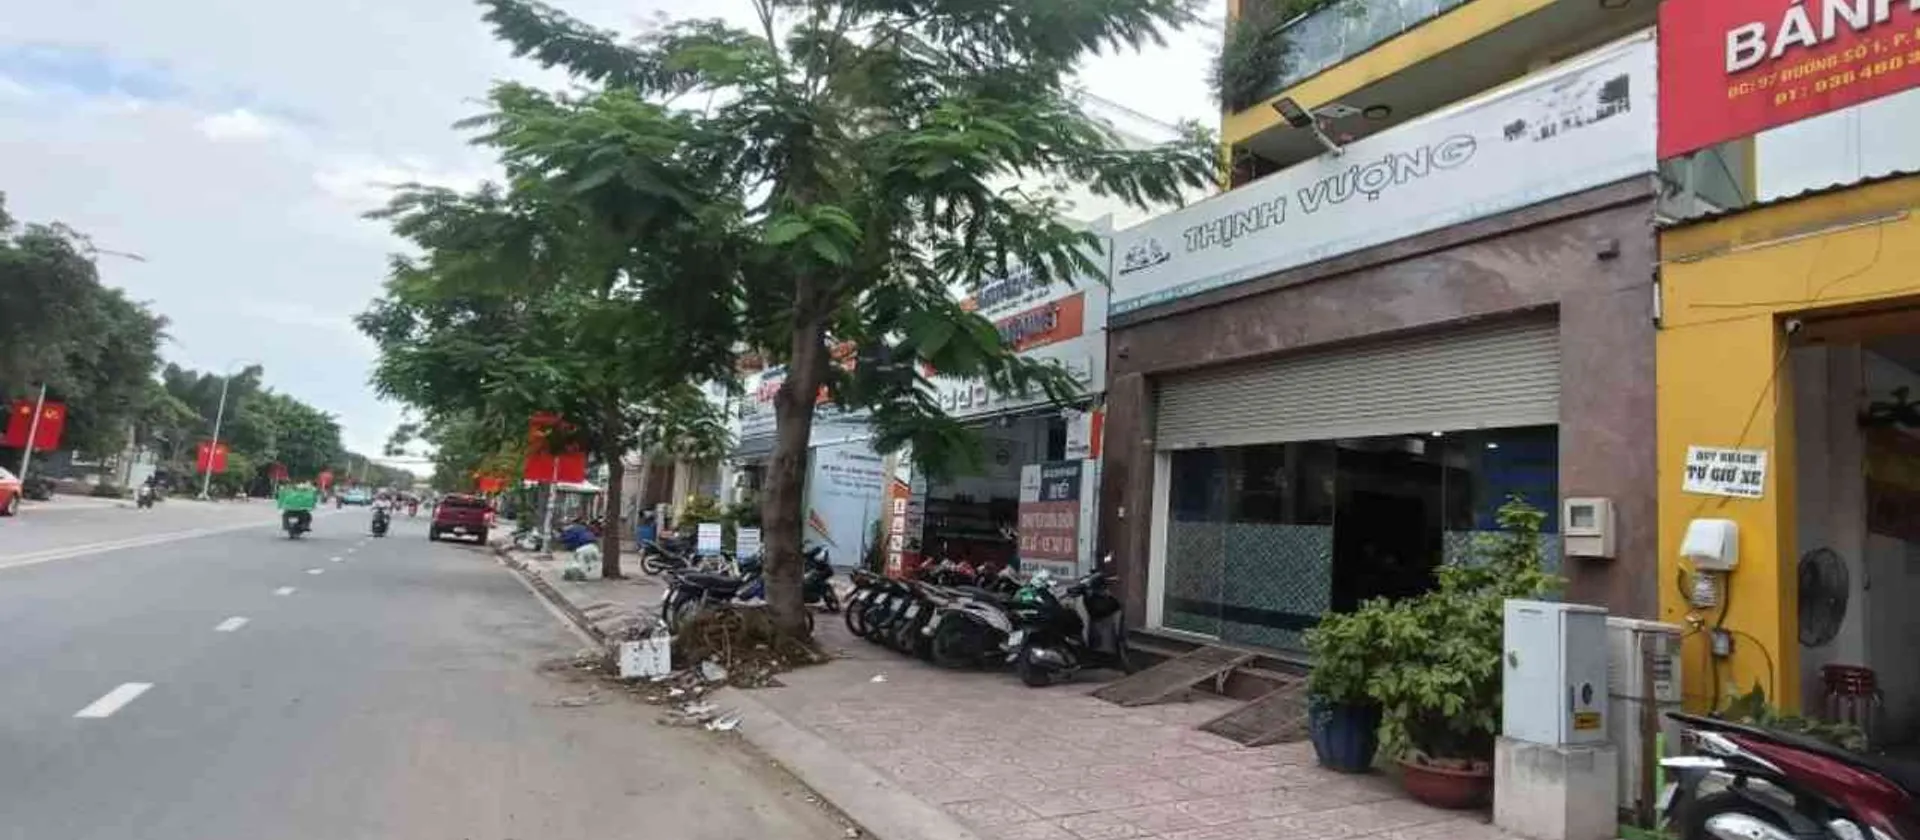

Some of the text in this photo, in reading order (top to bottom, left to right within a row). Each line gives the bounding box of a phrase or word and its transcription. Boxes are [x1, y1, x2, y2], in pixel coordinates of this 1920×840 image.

[1183, 135, 1477, 250] THỊNH VƯỢNG
[1740, 470, 1762, 485] XE
